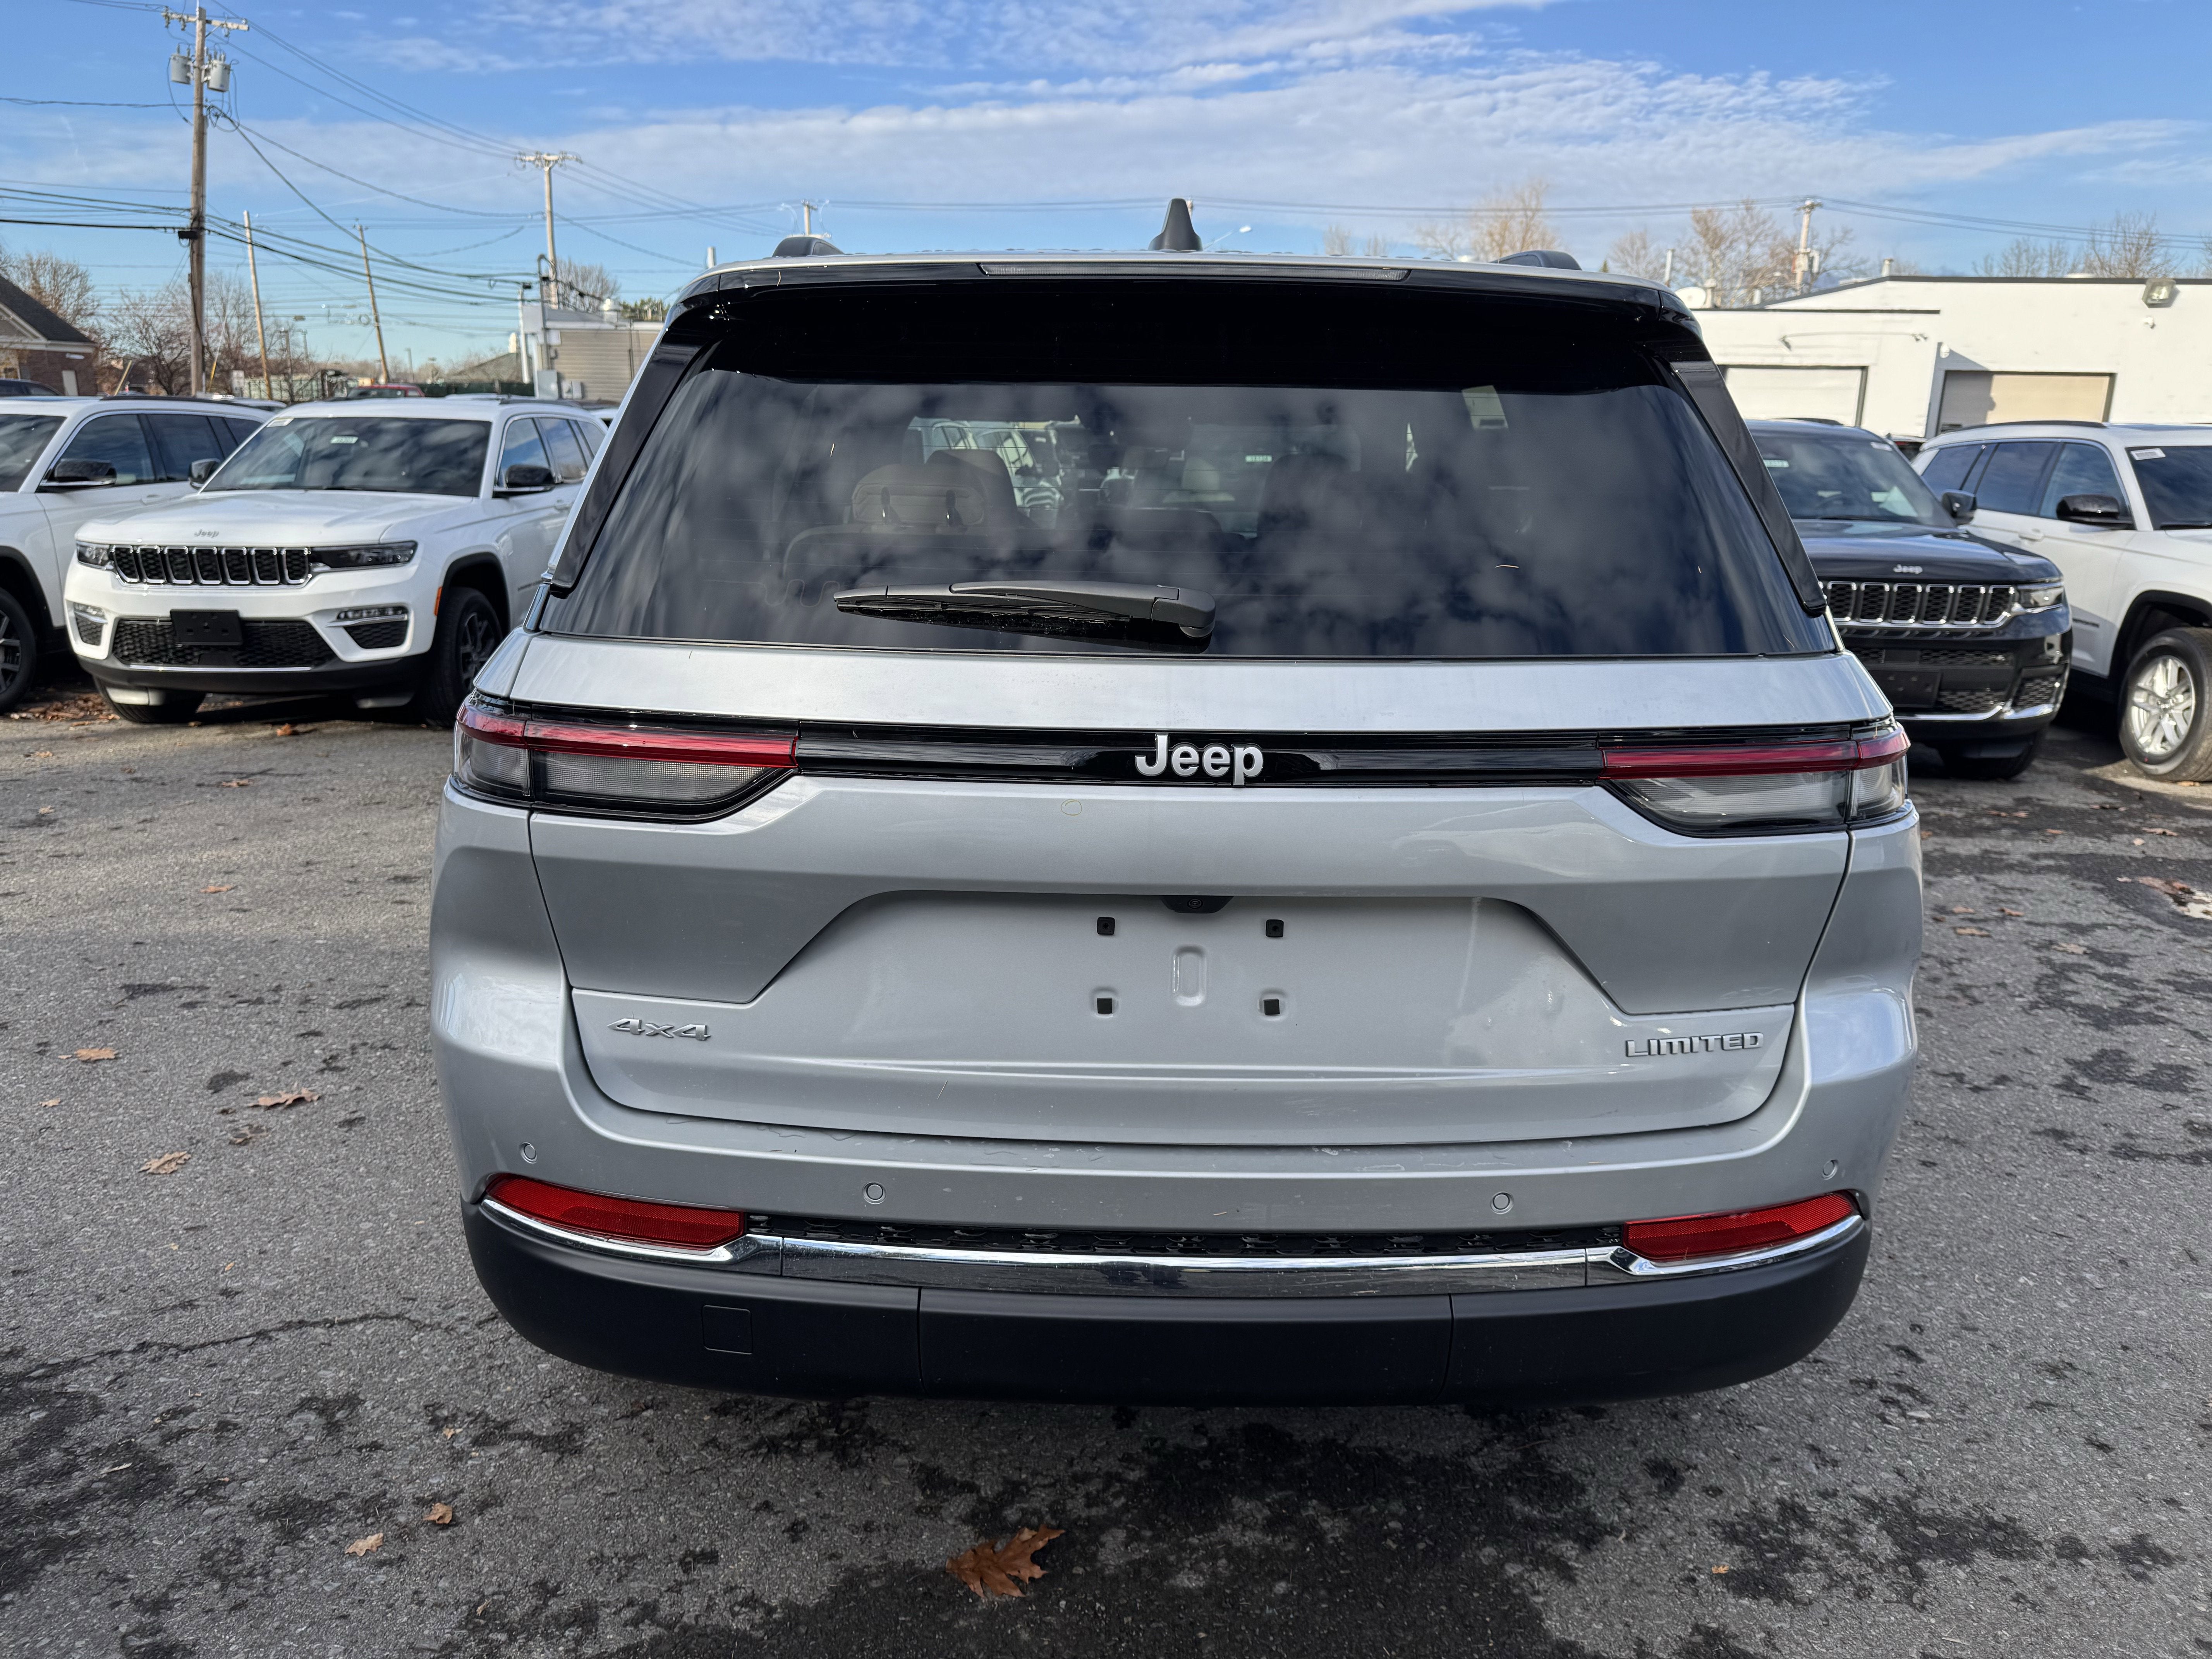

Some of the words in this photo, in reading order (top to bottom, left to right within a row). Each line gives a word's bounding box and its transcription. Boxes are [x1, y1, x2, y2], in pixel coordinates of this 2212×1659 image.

[1135, 733, 1264, 787] Jeep
[607, 1018, 711, 1041] 4x4
[1626, 1032, 1764, 1057] LIMITED
